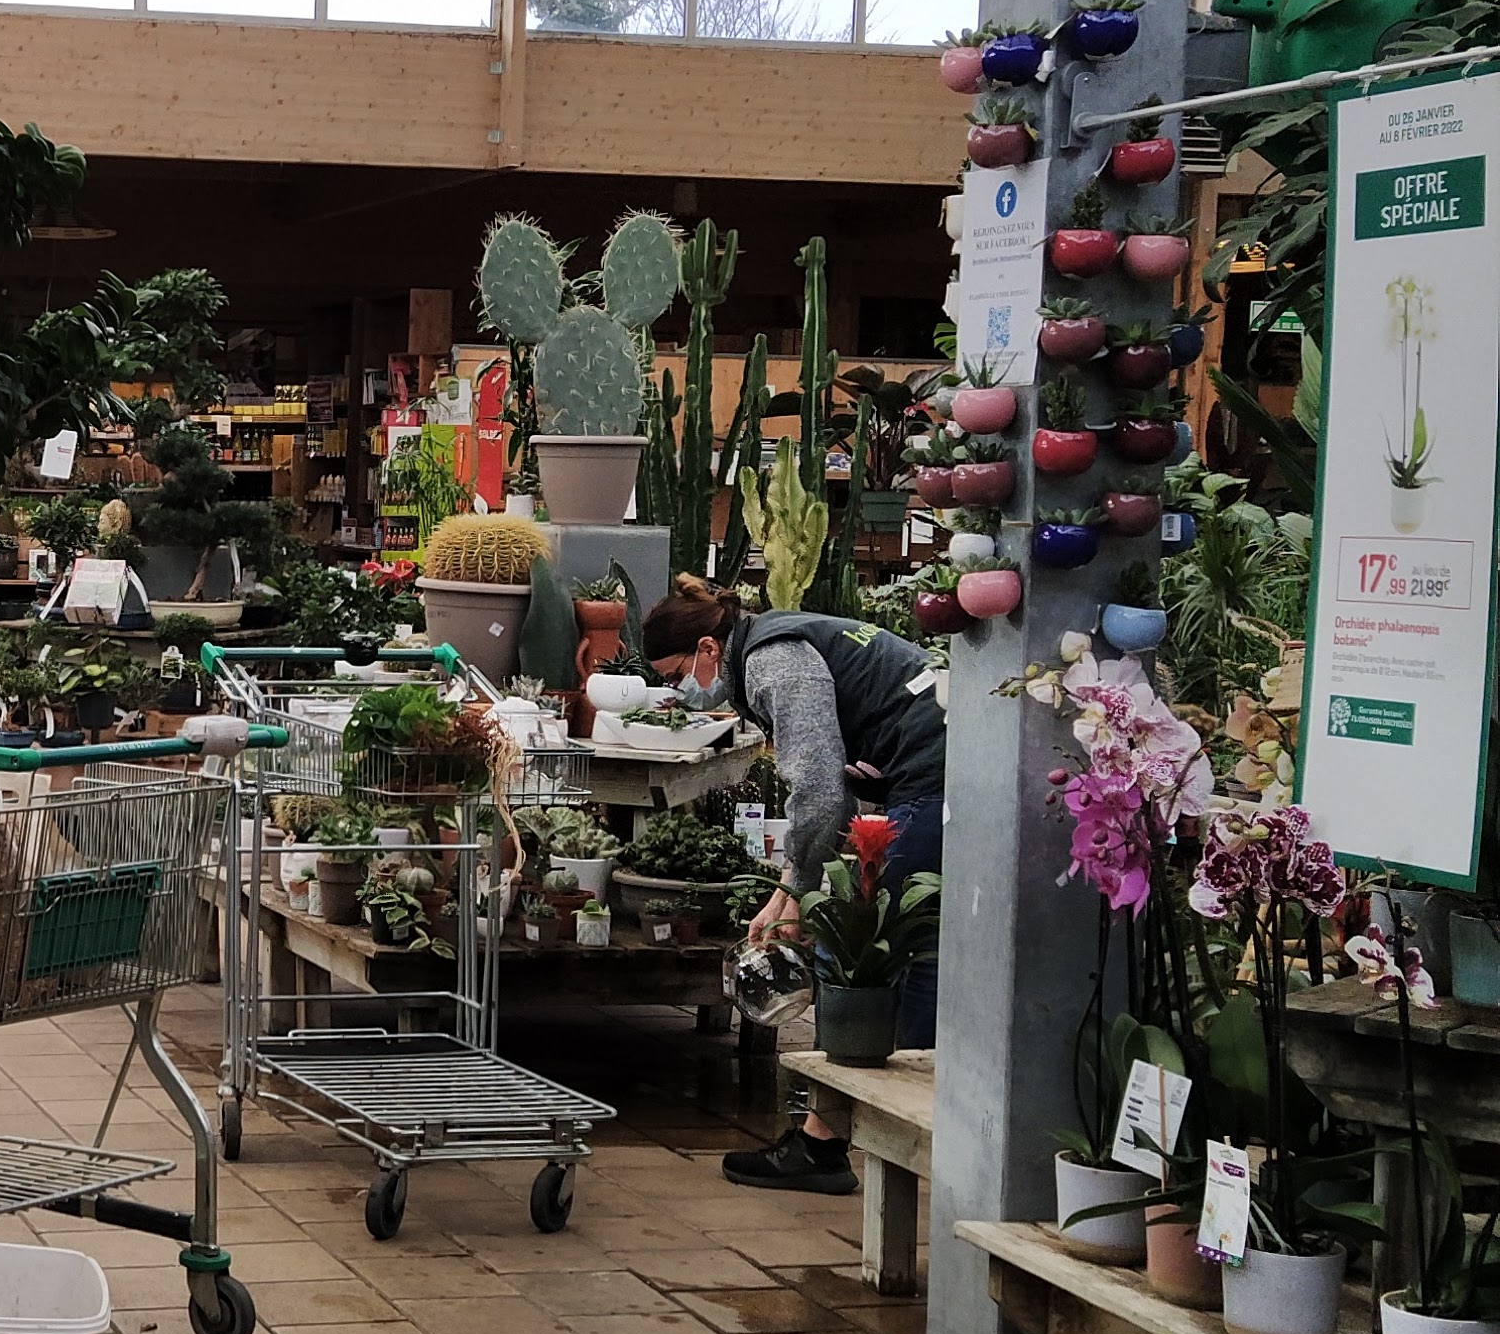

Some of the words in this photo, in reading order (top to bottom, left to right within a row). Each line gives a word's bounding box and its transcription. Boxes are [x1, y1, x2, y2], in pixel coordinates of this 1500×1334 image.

[1388, 113, 1401, 127] DU
[1402, 111, 1414, 125] 26
[1416, 104, 1455, 123] JANVIER
[1379, 130, 1392, 144] AU
[1401, 124, 1440, 141] FÉVRIER
[1393, 170, 1449, 199] OFFRE
[1380, 196, 1461, 229] SPÉCIALE
[1378, 619, 1440, 636] phalaenopsis
